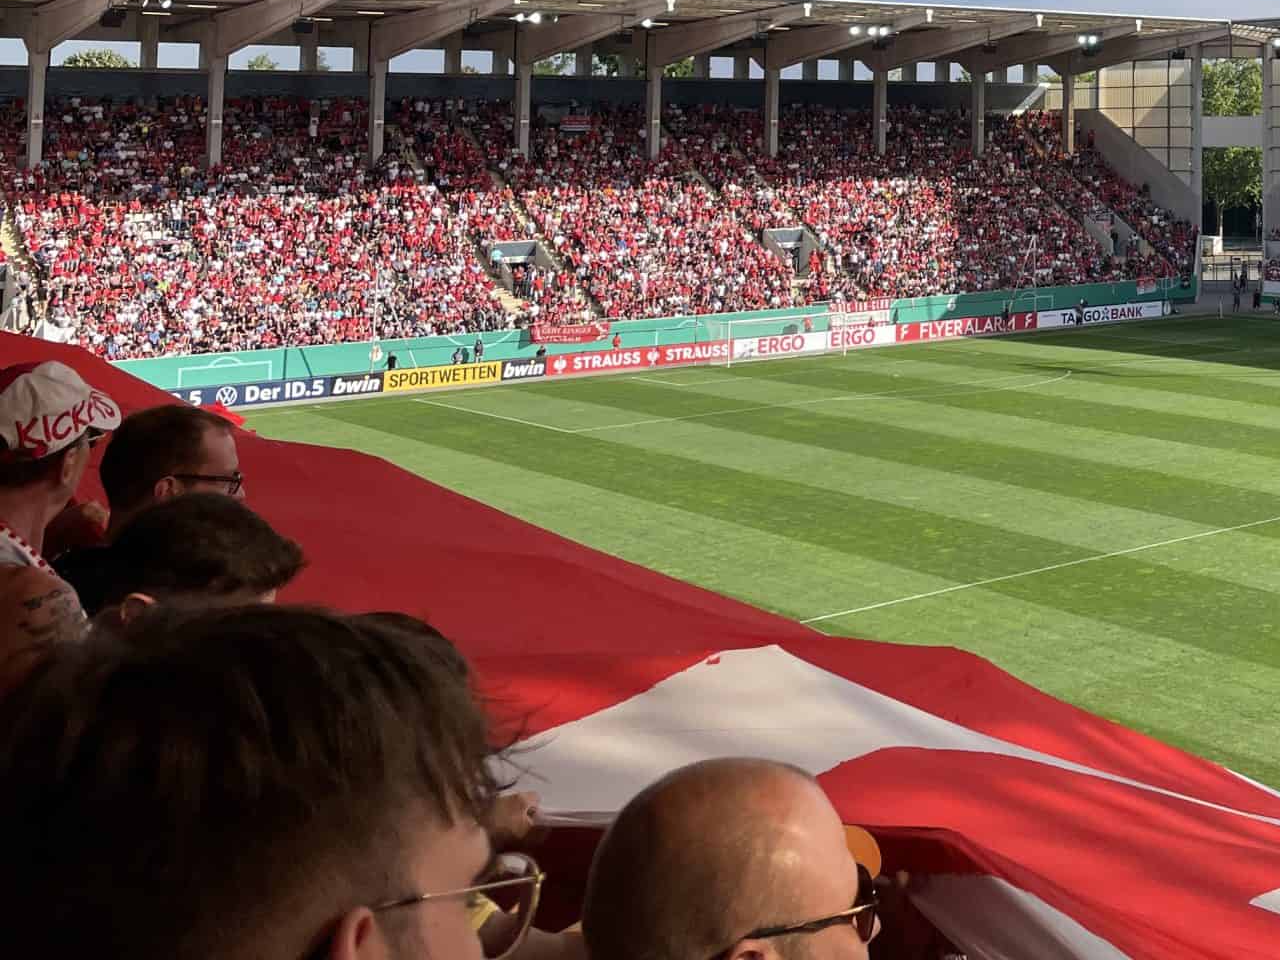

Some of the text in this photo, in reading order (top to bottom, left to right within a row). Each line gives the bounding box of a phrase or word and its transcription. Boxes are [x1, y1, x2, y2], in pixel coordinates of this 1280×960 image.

[919, 315, 1016, 339] FLYERALARM
[1060, 309, 1101, 325] TAGO
[757, 335, 805, 355] ERGO
[830, 328, 876, 348] ERGO
[573, 351, 641, 369] STRAUSS
[665, 343, 729, 361] STRAUSS
[389, 364, 497, 388] SPORTWETTEN
[503, 359, 545, 378] bwin
[244, 378, 324, 403] Der ID.5
[333, 375, 381, 395] bwin
